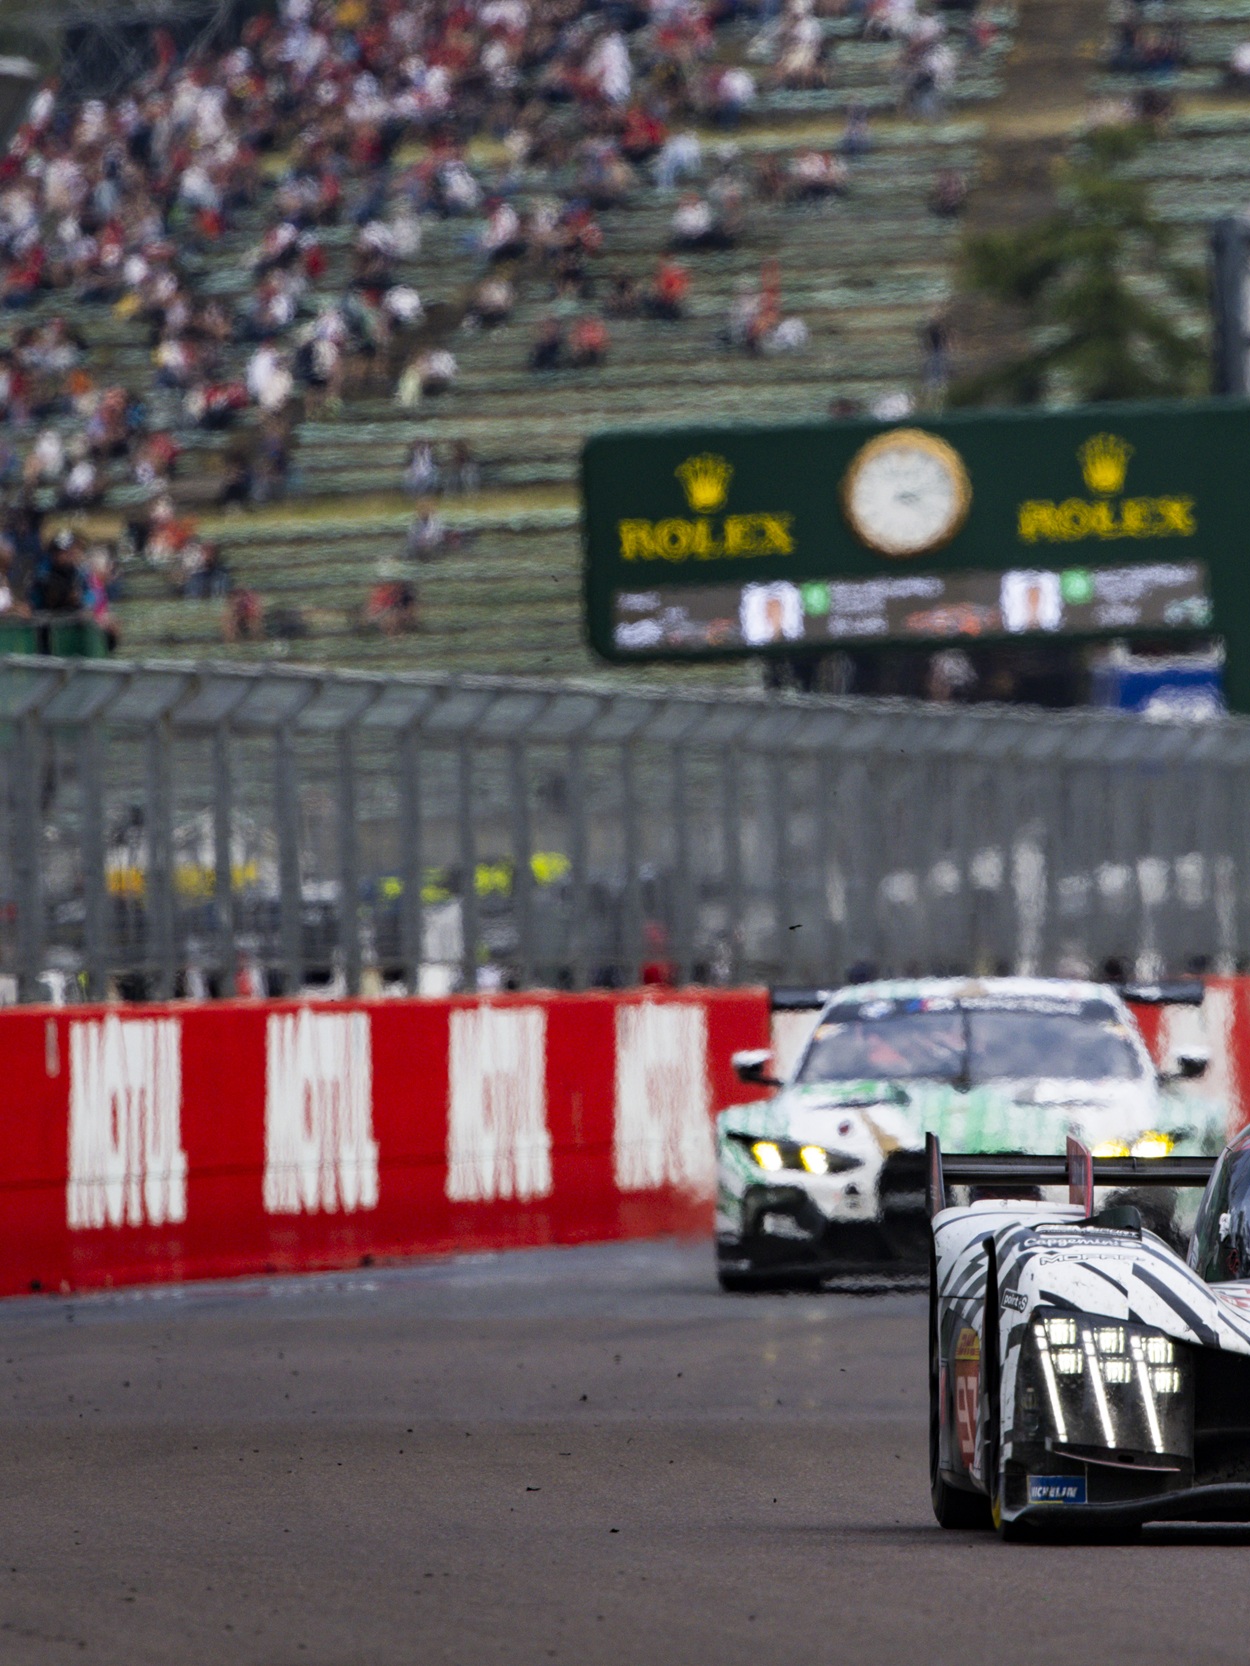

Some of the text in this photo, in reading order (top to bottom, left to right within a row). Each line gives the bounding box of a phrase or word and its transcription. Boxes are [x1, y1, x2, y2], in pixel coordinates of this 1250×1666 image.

[618, 512, 796, 562] ROLEX
[1018, 495, 1197, 544] ROLEX
[1024, 1236, 1121, 1248] Capgemini
